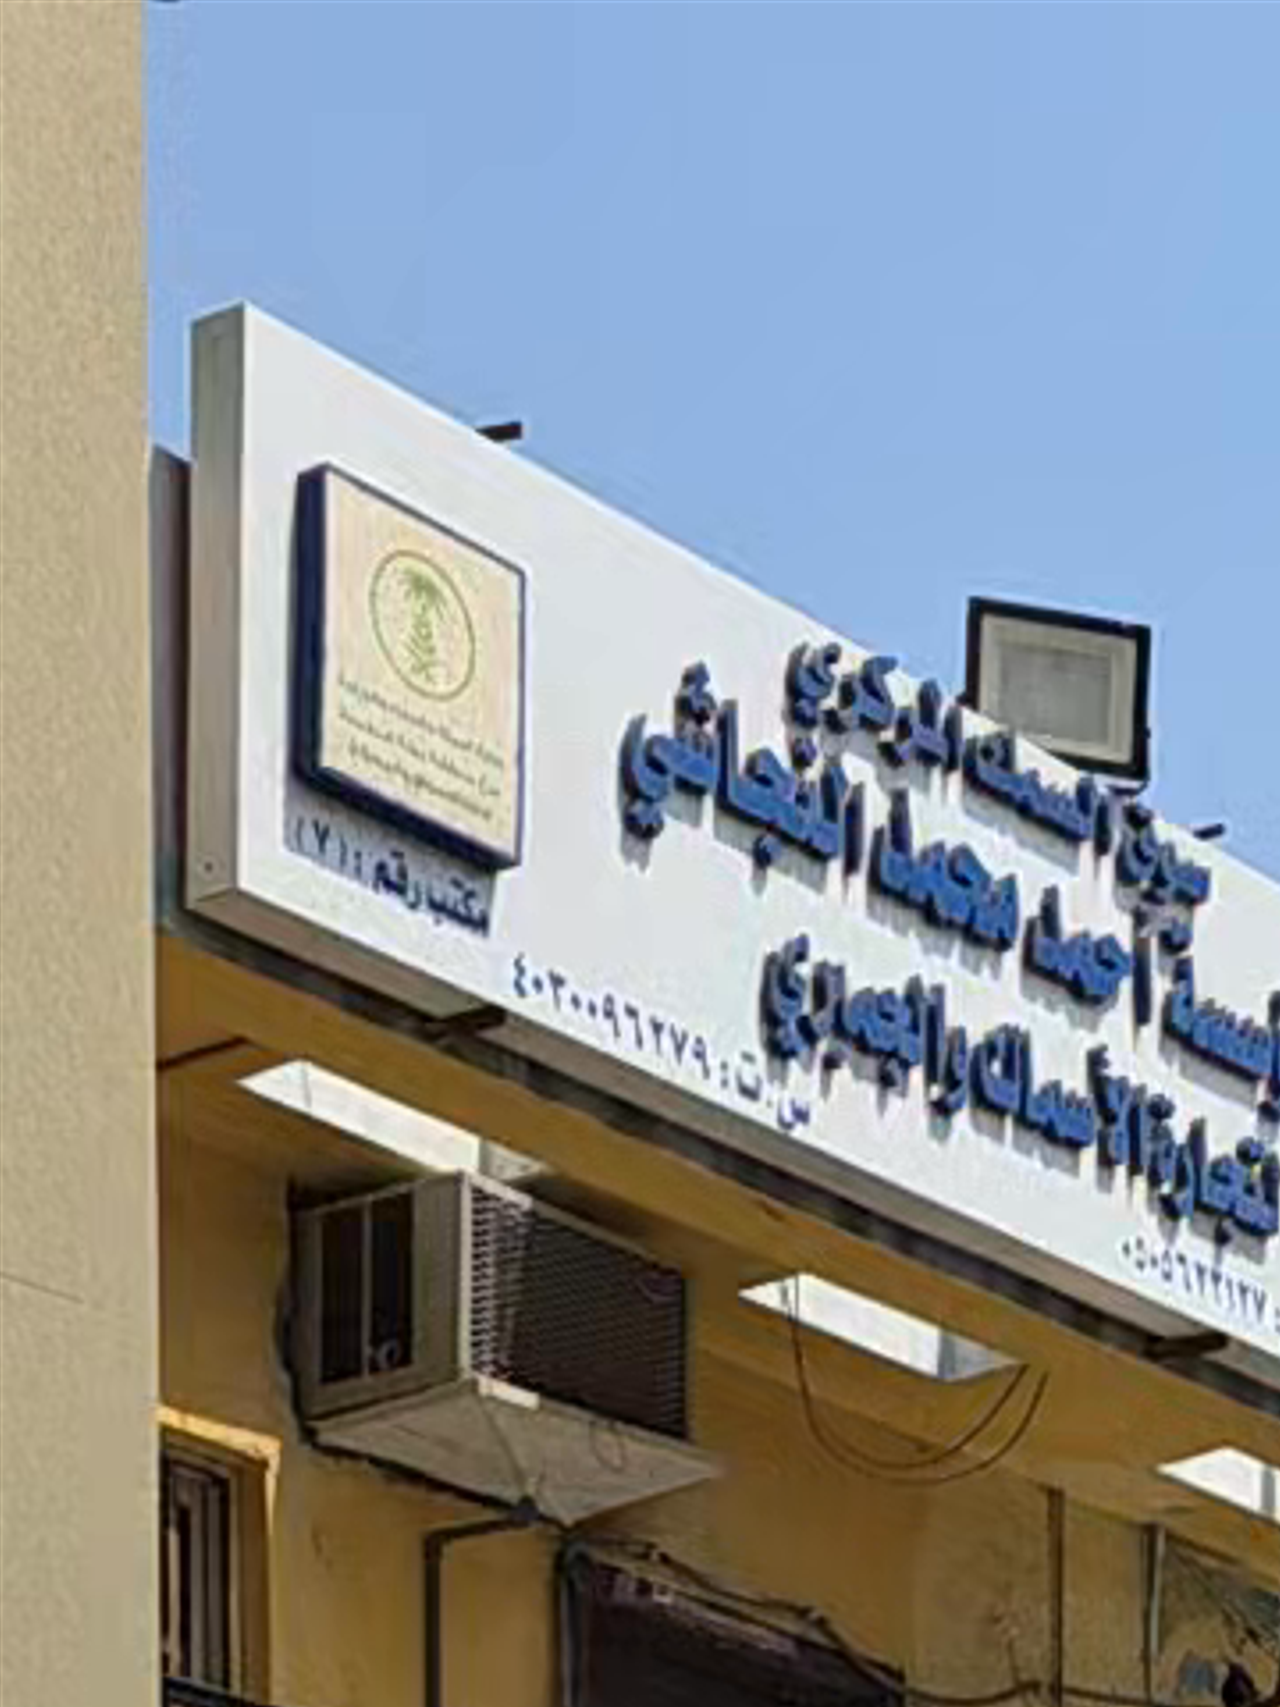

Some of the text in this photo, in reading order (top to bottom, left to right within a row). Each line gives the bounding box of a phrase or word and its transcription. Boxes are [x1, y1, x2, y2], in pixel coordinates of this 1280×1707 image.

[616, 662, 866, 877] النجاشي
[784, 642, 1210, 902] سوق السمك المركزي
[427, 872, 490, 936] مكتب
[868, 788, 1020, 950] محمد
